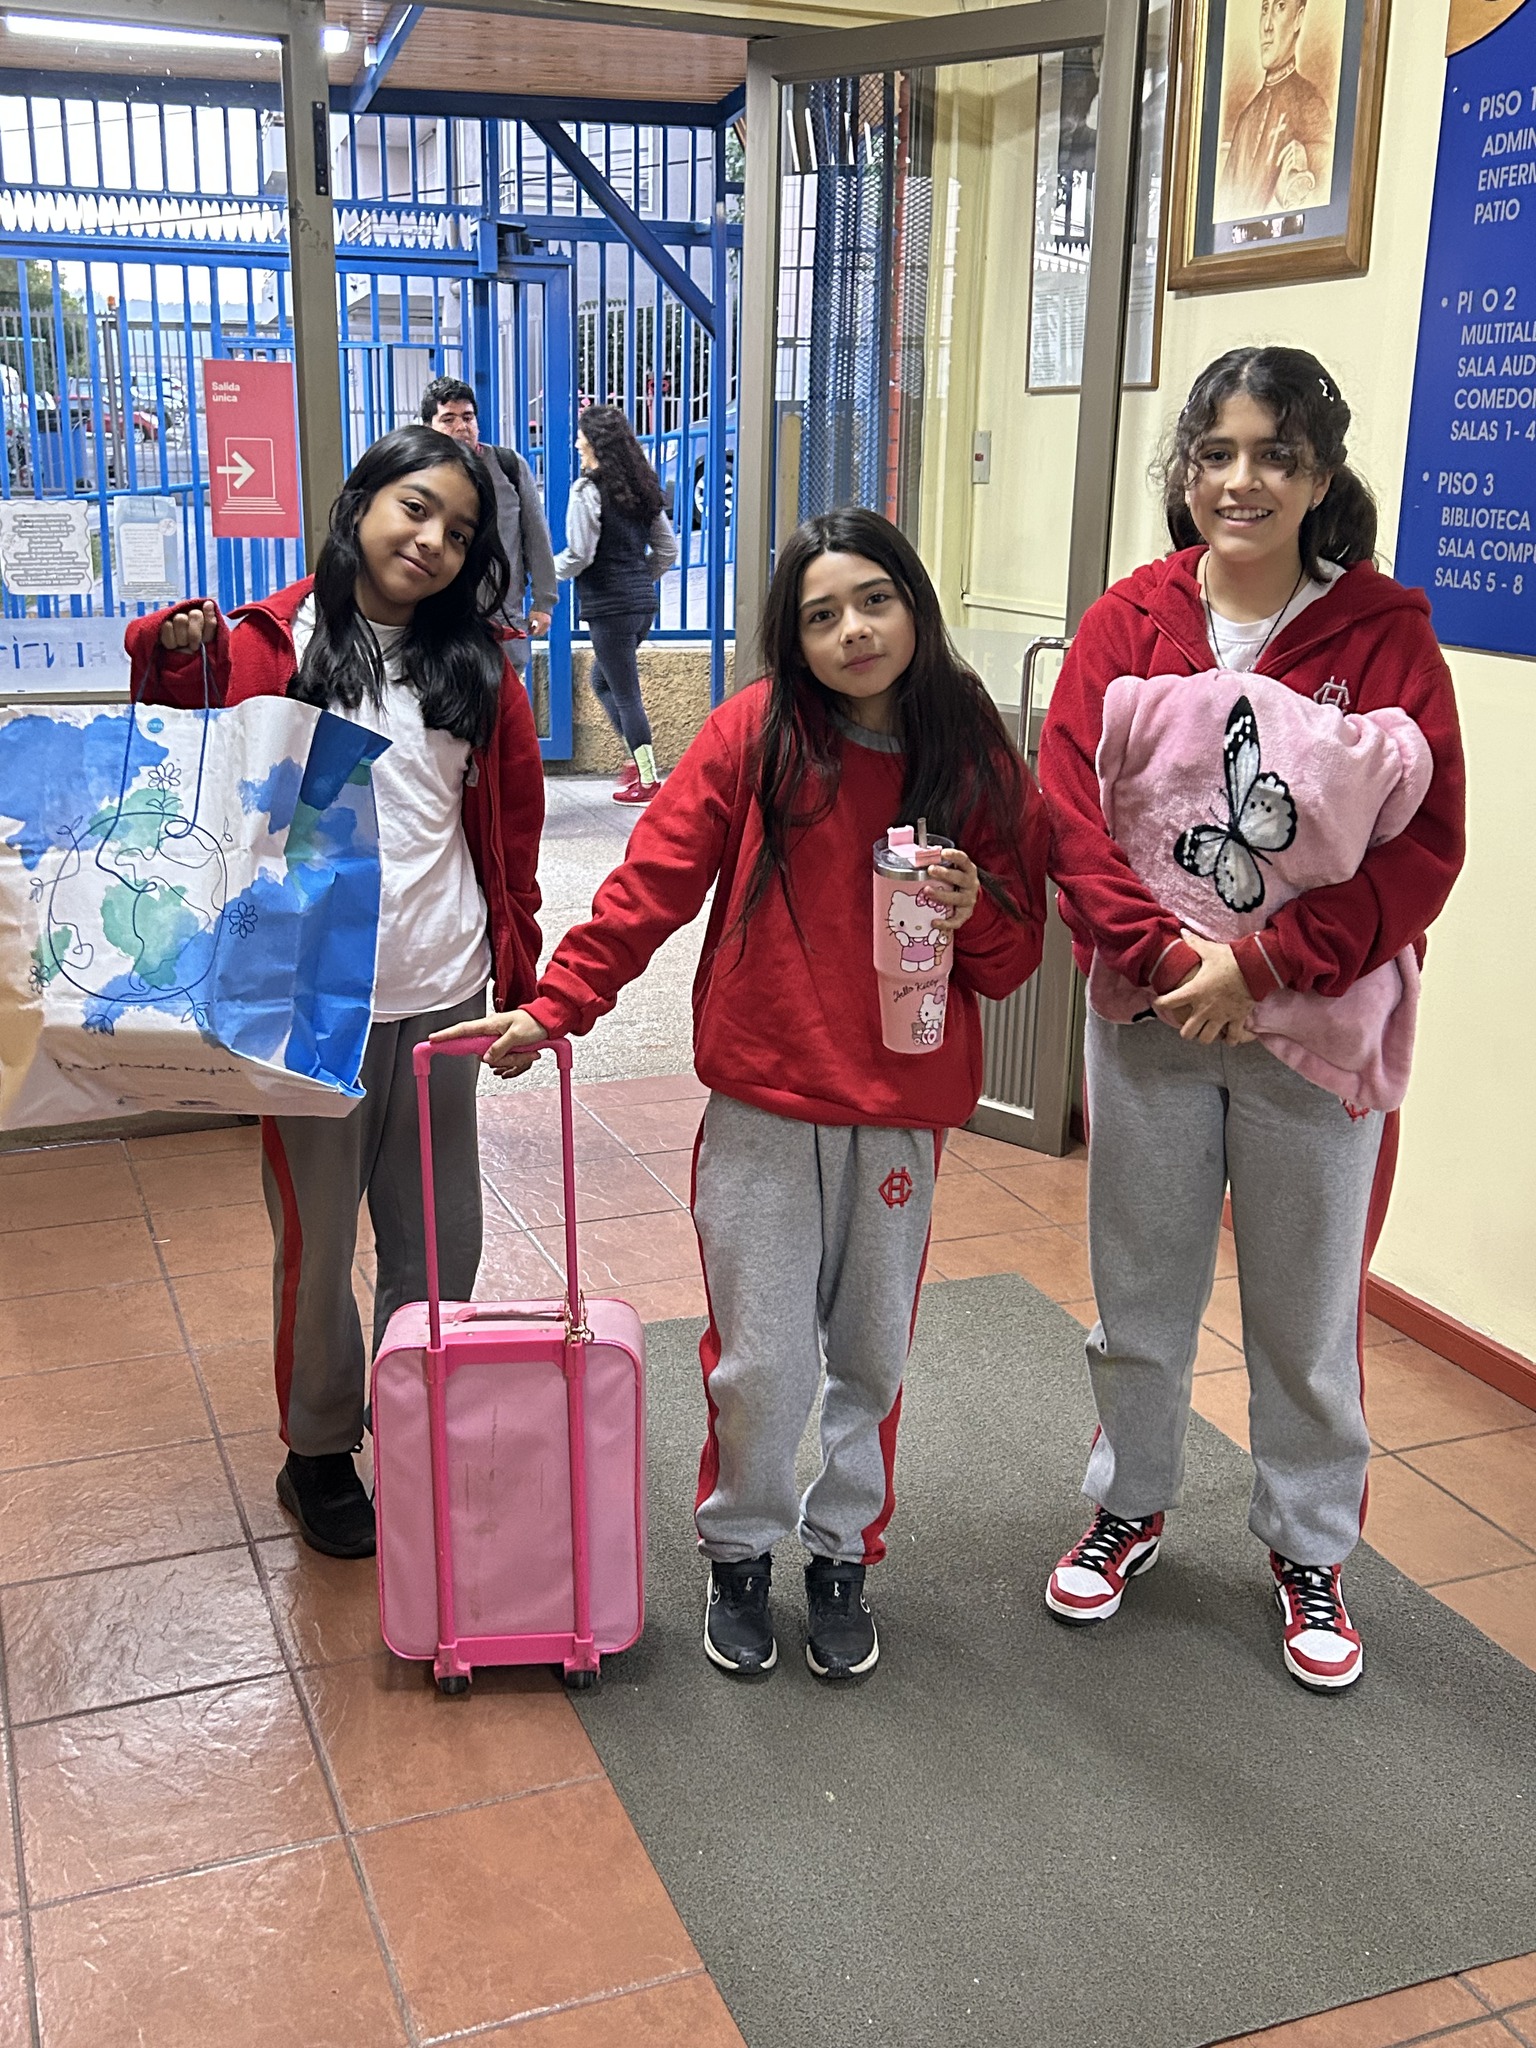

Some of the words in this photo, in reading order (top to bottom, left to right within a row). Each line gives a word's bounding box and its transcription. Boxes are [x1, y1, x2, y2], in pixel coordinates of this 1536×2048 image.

[1478, 90, 1522, 122] PISO
[1473, 198, 1520, 225] PATIO
[1503, 287, 1517, 311] 2
[1457, 356, 1496, 377] SALA
[211, 380, 241, 391] Salida
[212, 392, 238, 402] única
[1454, 387, 1536, 409] COMEDO
[1450, 420, 1498, 441] SALAS
[1437, 471, 1478, 496] PISO
[1482, 473, 1494, 496] 3
[1441, 506, 1531, 531] BIBLIOTECA
[1437, 536, 1476, 559] SALA
[1434, 566, 1482, 591] SALAS
[893, 985, 914, 1003] Hello
[914, 979, 939, 992] Kitty
